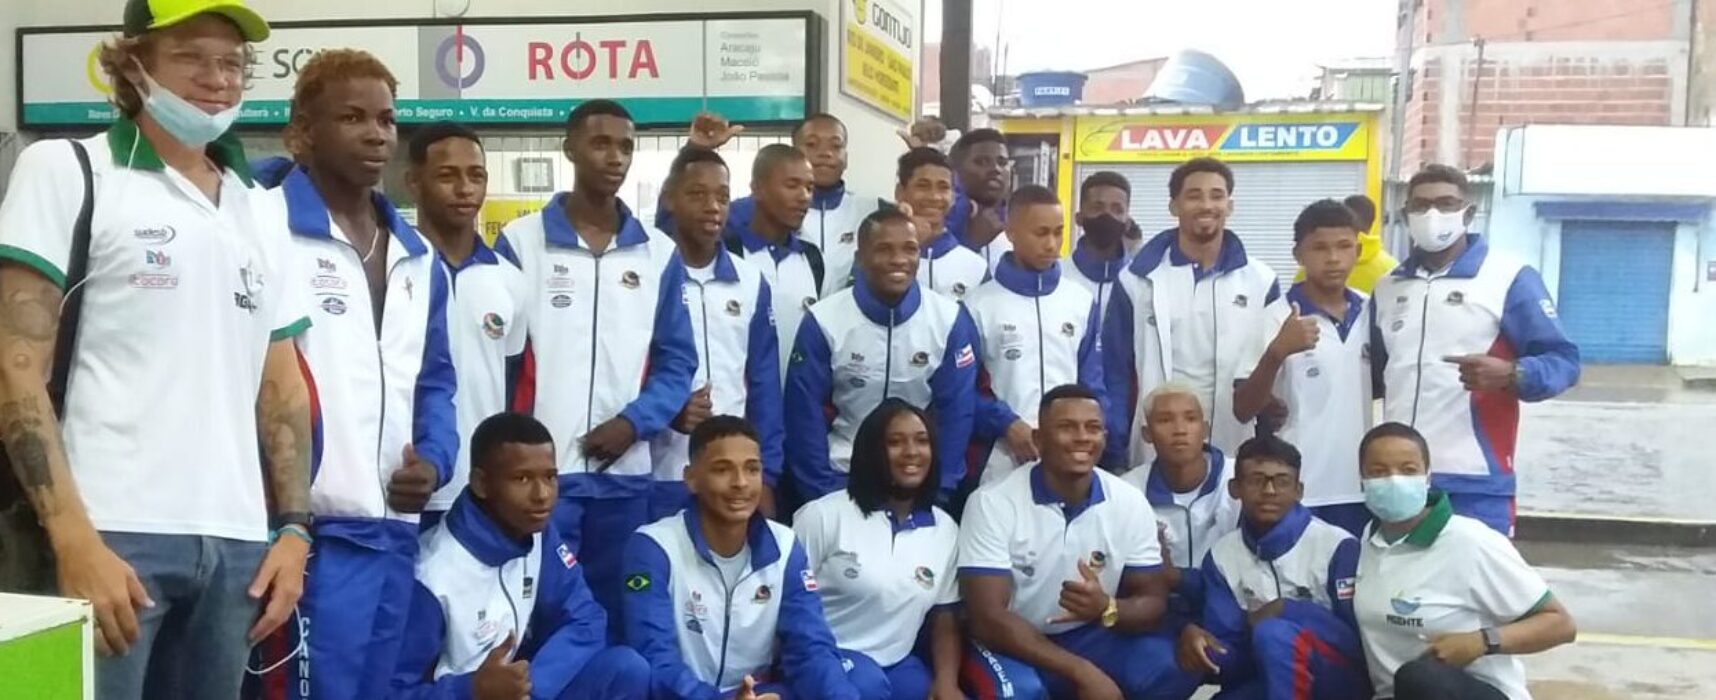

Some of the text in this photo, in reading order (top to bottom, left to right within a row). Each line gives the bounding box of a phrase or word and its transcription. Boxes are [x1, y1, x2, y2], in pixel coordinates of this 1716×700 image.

[528, 33, 660, 81] ROTA
[720, 42, 761, 54] Aracaju
[272, 48, 314, 79] SO
[415, 106, 453, 119] Seguro
[482, 106, 495, 117] da
[498, 106, 553, 119] Conquista
[1121, 126, 1339, 149] LAVA LENTO
[299, 616, 311, 700] CANO
